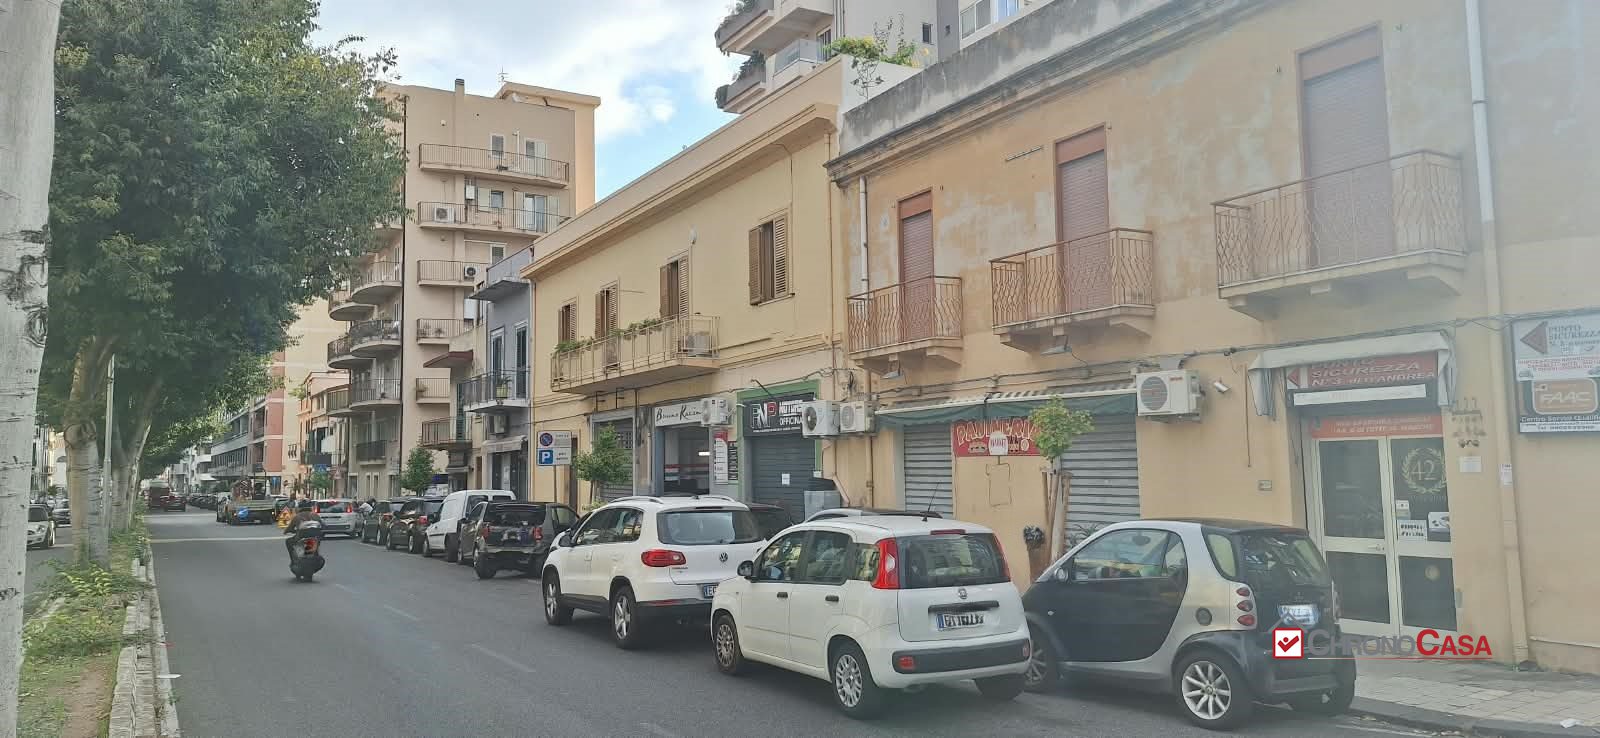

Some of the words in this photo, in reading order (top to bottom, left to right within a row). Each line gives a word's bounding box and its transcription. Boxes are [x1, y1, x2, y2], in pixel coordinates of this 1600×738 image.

[1311, 362, 1420, 378] SICUREZZA
[1540, 390, 1592, 404] FAAC
[779, 414, 803, 426] OFFICINA
[1411, 460, 1437, 481] 42
